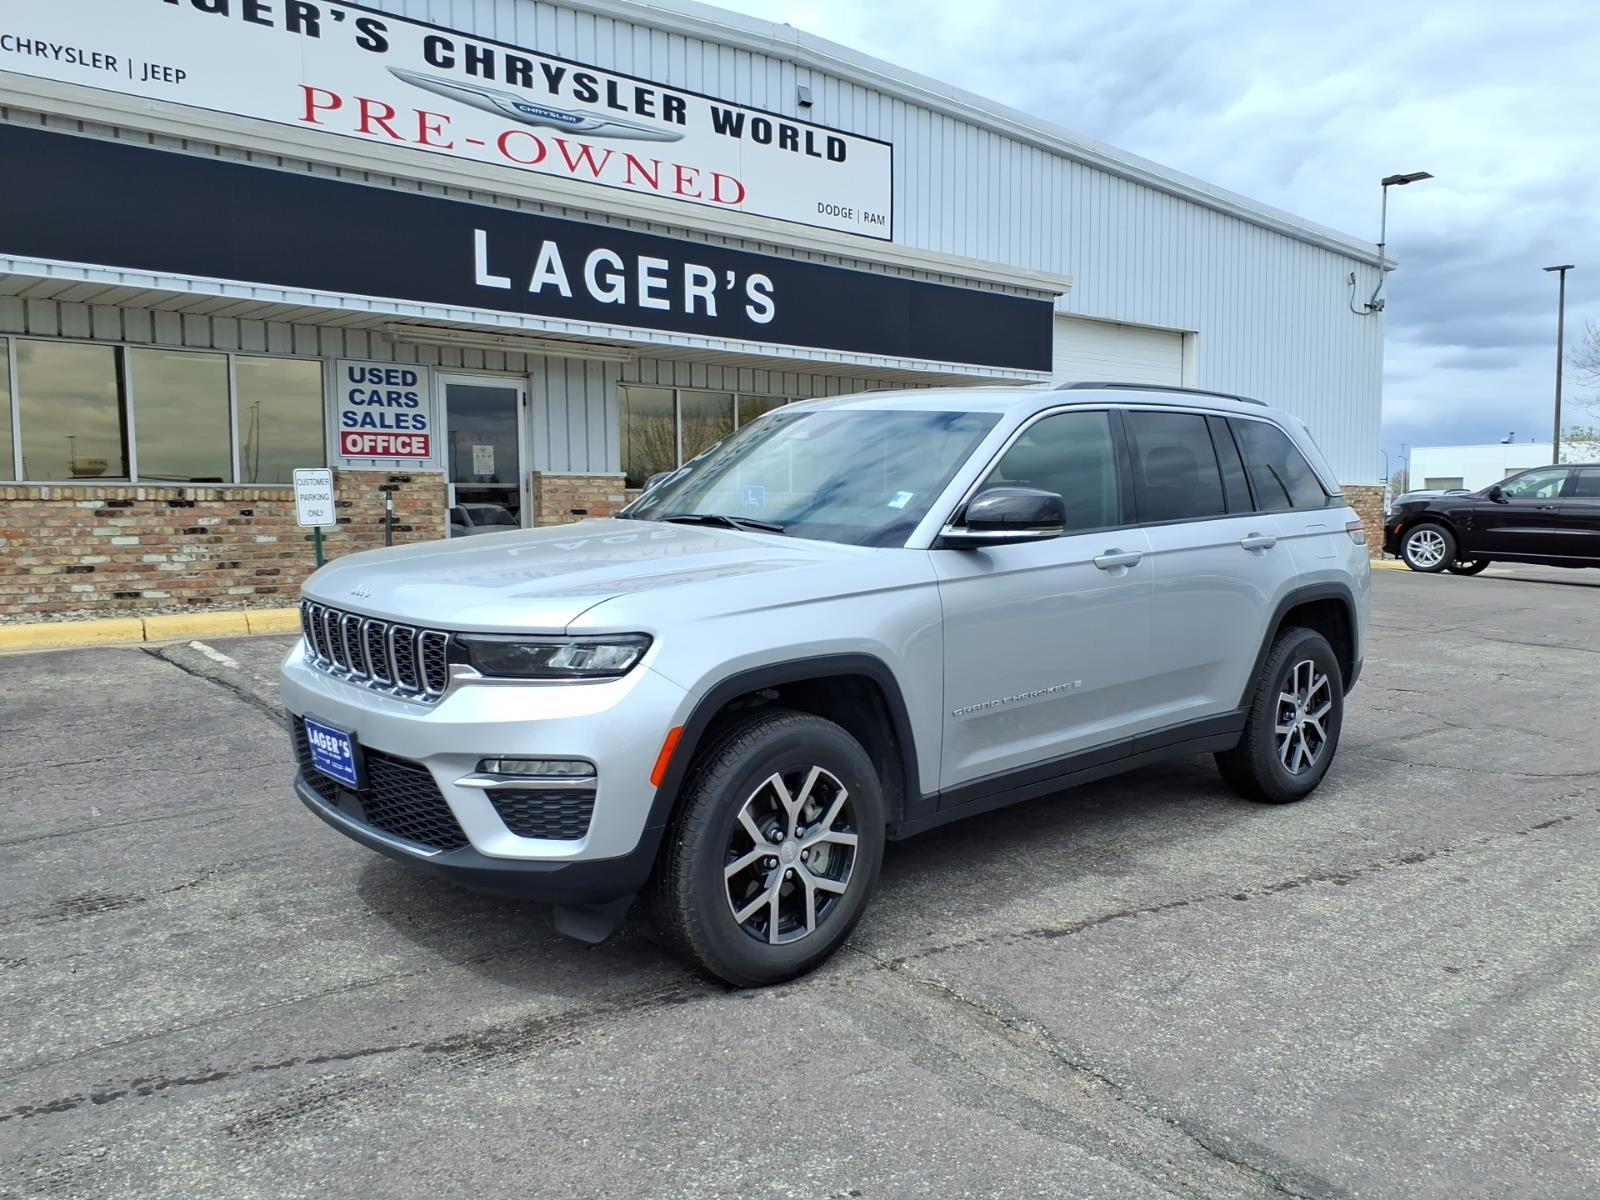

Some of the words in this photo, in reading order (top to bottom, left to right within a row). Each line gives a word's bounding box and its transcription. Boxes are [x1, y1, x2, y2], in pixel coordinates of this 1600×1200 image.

[0, 34, 118, 73] CHRYSLER
[141, 62, 187, 85] JEEP
[424, 34, 687, 126] CHRYSLER
[710, 106, 848, 164] WORLD
[519, 105, 577, 122] CHRYSLER
[298, 84, 746, 205] PRE-OWNED
[817, 202, 853, 220] DODGE
[863, 211, 885, 226] RAM
[474, 228, 776, 325] LAGER'S
[348, 366, 418, 387] USED
[348, 388, 419, 409] CARS
[342, 410, 427, 431] SALES
[345, 434, 426, 455] OFFICE
[297, 478, 330, 486] CUSTOMER
[300, 493, 330, 501] PARKING
[308, 509, 324, 518] ONLY
[306, 727, 350, 758] LAGER'S
